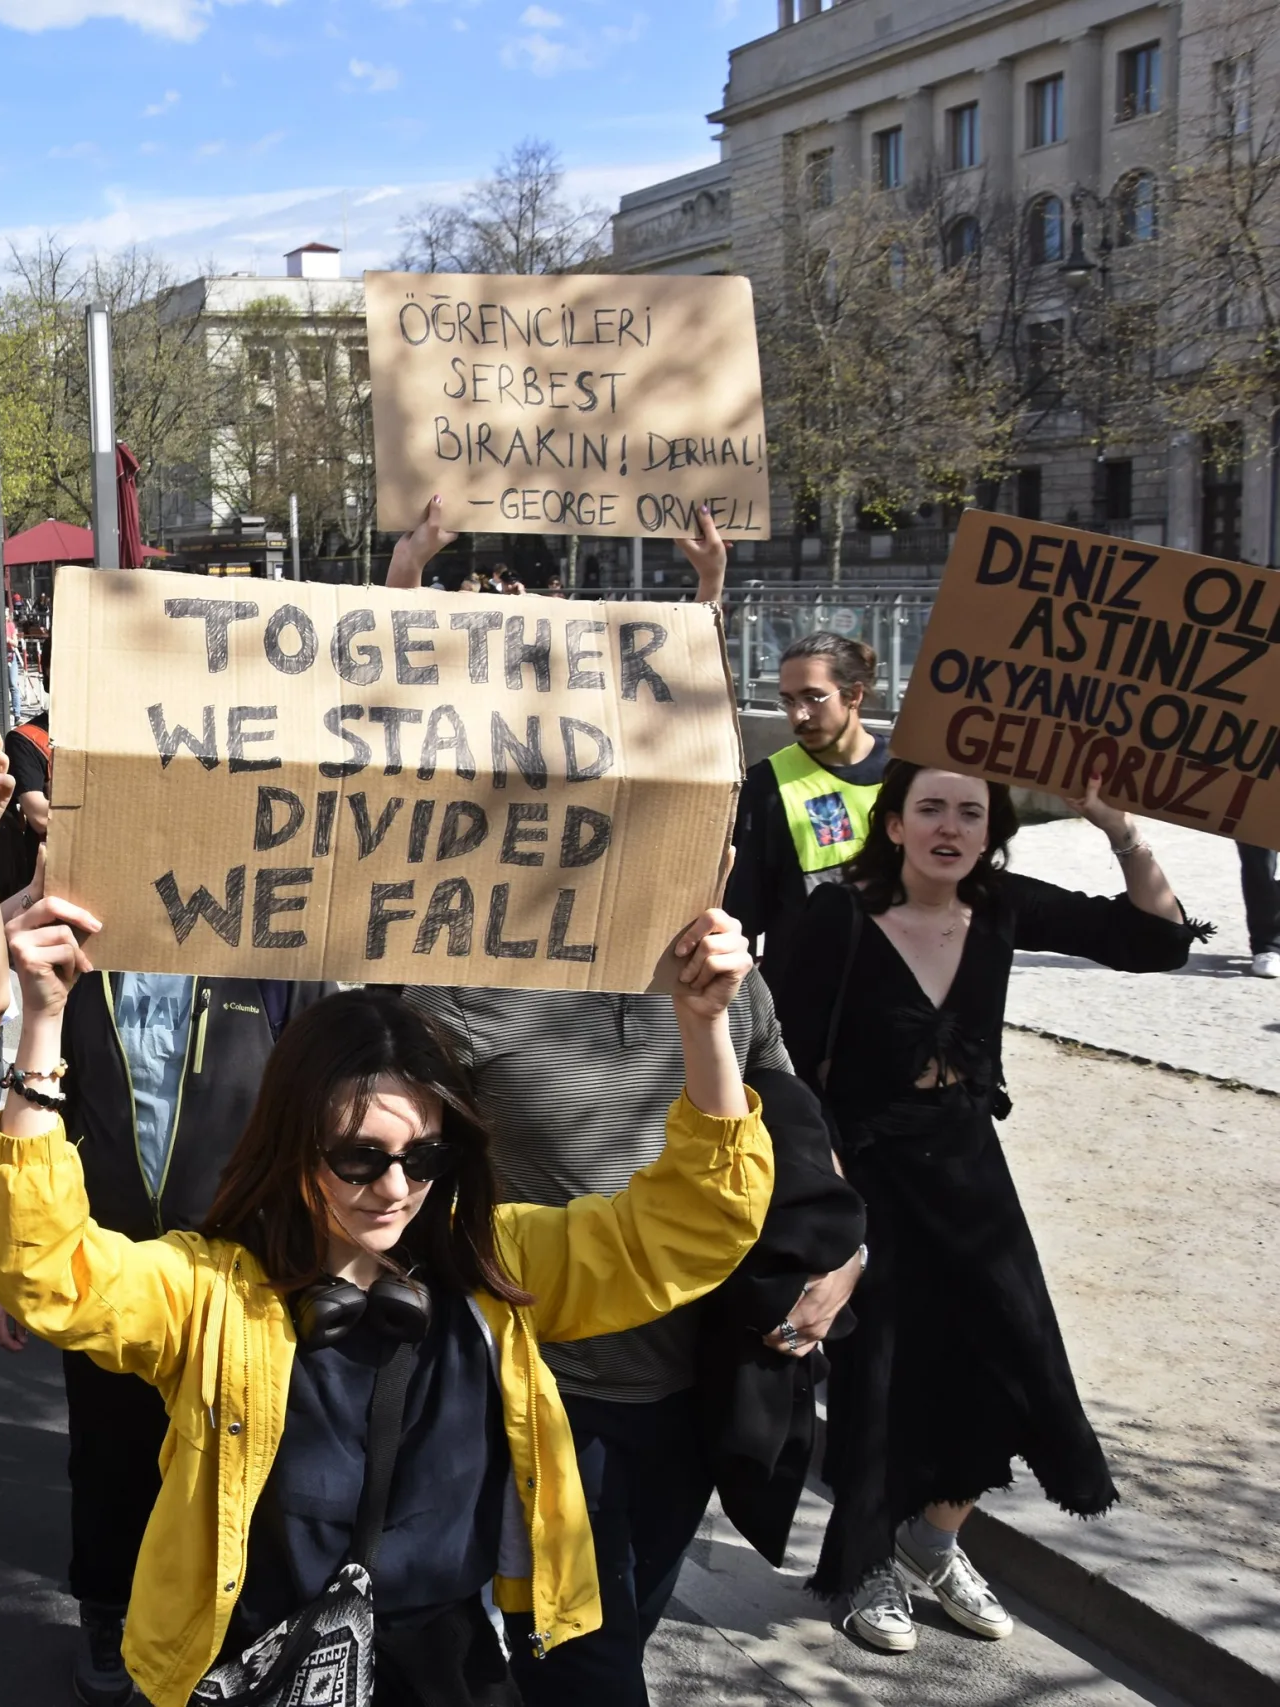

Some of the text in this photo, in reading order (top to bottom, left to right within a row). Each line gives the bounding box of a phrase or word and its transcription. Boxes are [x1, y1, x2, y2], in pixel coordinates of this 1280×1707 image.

[443, 356, 627, 413] SERBEST
[434, 415, 628, 476] BIRAKIN!
[636, 492, 762, 537] ORWELL
[976, 525, 1280, 645] DENİZ OL
[164, 598, 674, 703] TOGETHER
[930, 648, 1142, 738] OKYANUS
[1009, 597, 1270, 703] ASTINIZ
[146, 703, 614, 790] WE STAND
[252, 785, 613, 869] DIVIDED
[150, 864, 598, 964] WE FALL
[229, 1002, 260, 1014] Columbia
